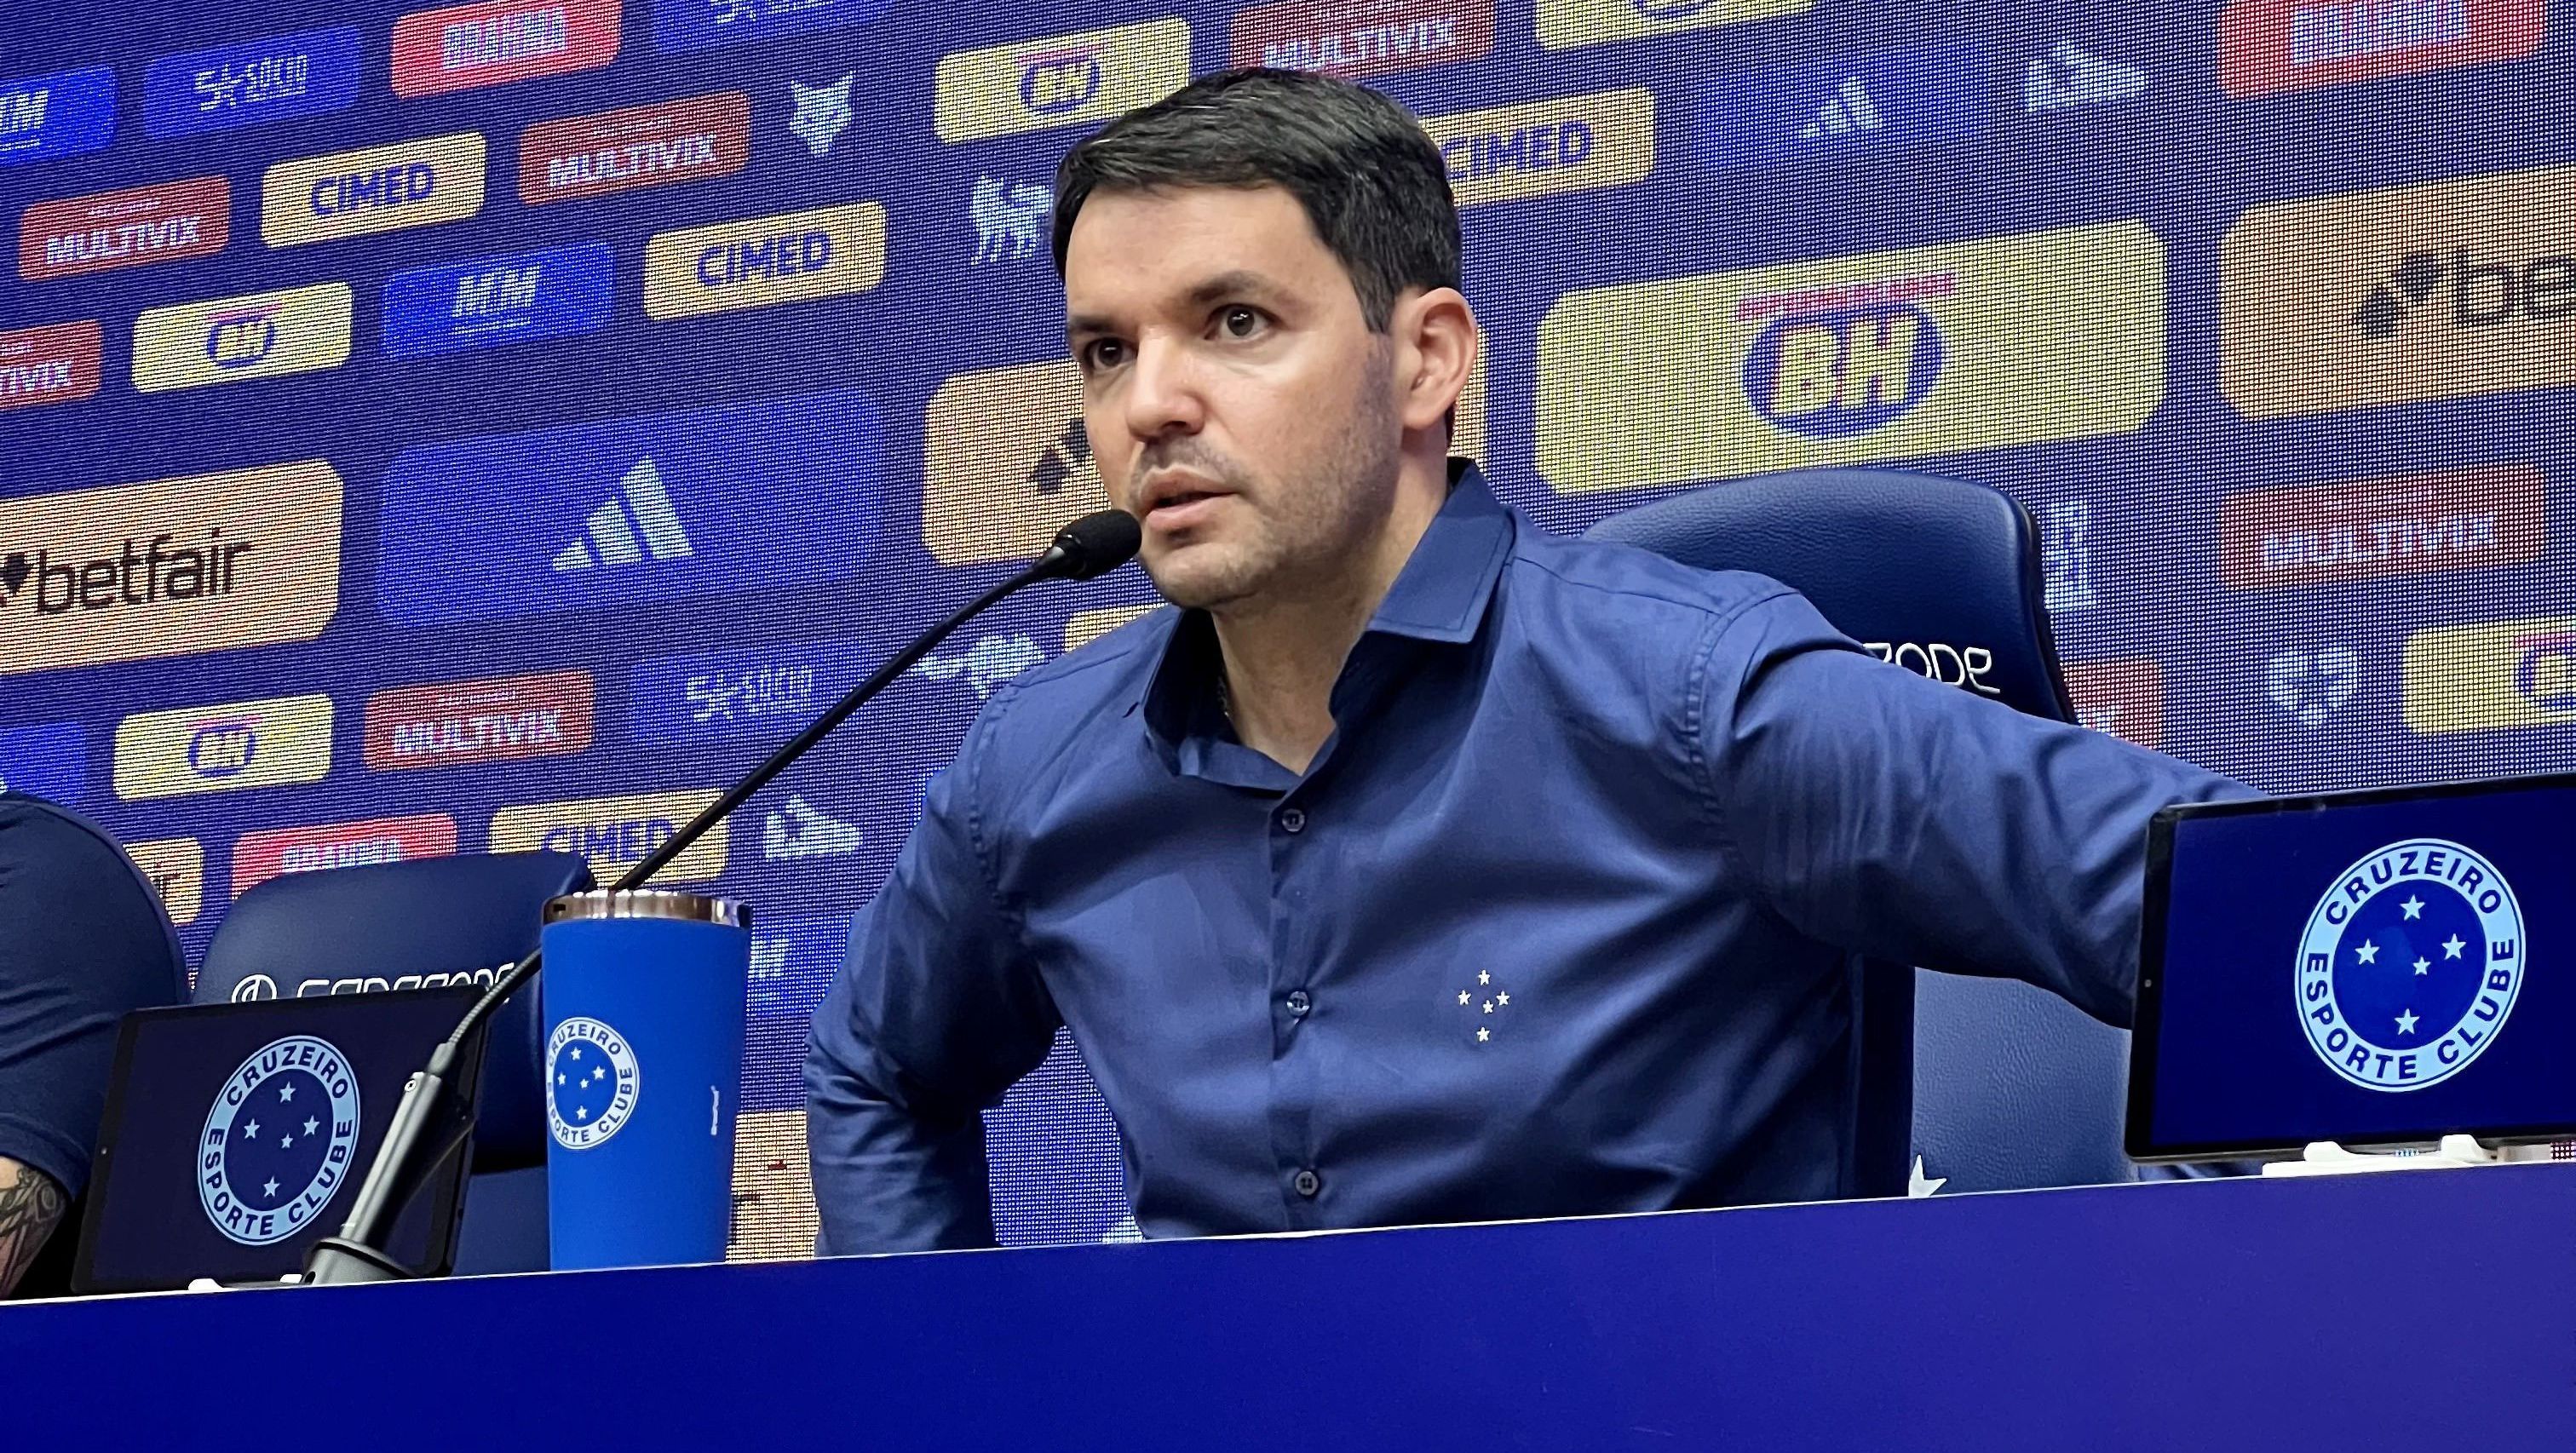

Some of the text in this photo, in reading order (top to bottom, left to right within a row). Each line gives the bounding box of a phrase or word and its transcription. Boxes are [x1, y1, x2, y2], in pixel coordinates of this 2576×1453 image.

[1262, 15, 1456, 72] MULTIVIX
[309, 163, 435, 216] CIMED
[548, 132, 718, 188] MULTIVIX
[46, 214, 202, 266] MULTIVIX
[695, 230, 832, 287] CIMED
[451, 263, 543, 319] MM
[1768, 309, 1923, 417] BH
[2260, 509, 2501, 571] MULTIVIX
[36, 525, 253, 615] betfair
[393, 708, 564, 757] MULTIVIX
[2325, 850, 2502, 926] CRUZEIRO
[2306, 938, 2516, 1081] ESPORTE CLUBE
[226, 1044, 349, 1106] CRUZEIRO
[548, 1023, 622, 1068] CRUZEIRO
[597, 1067, 633, 1134] CLUBE
[204, 1119, 354, 1236] ESPORTE CLUBE
